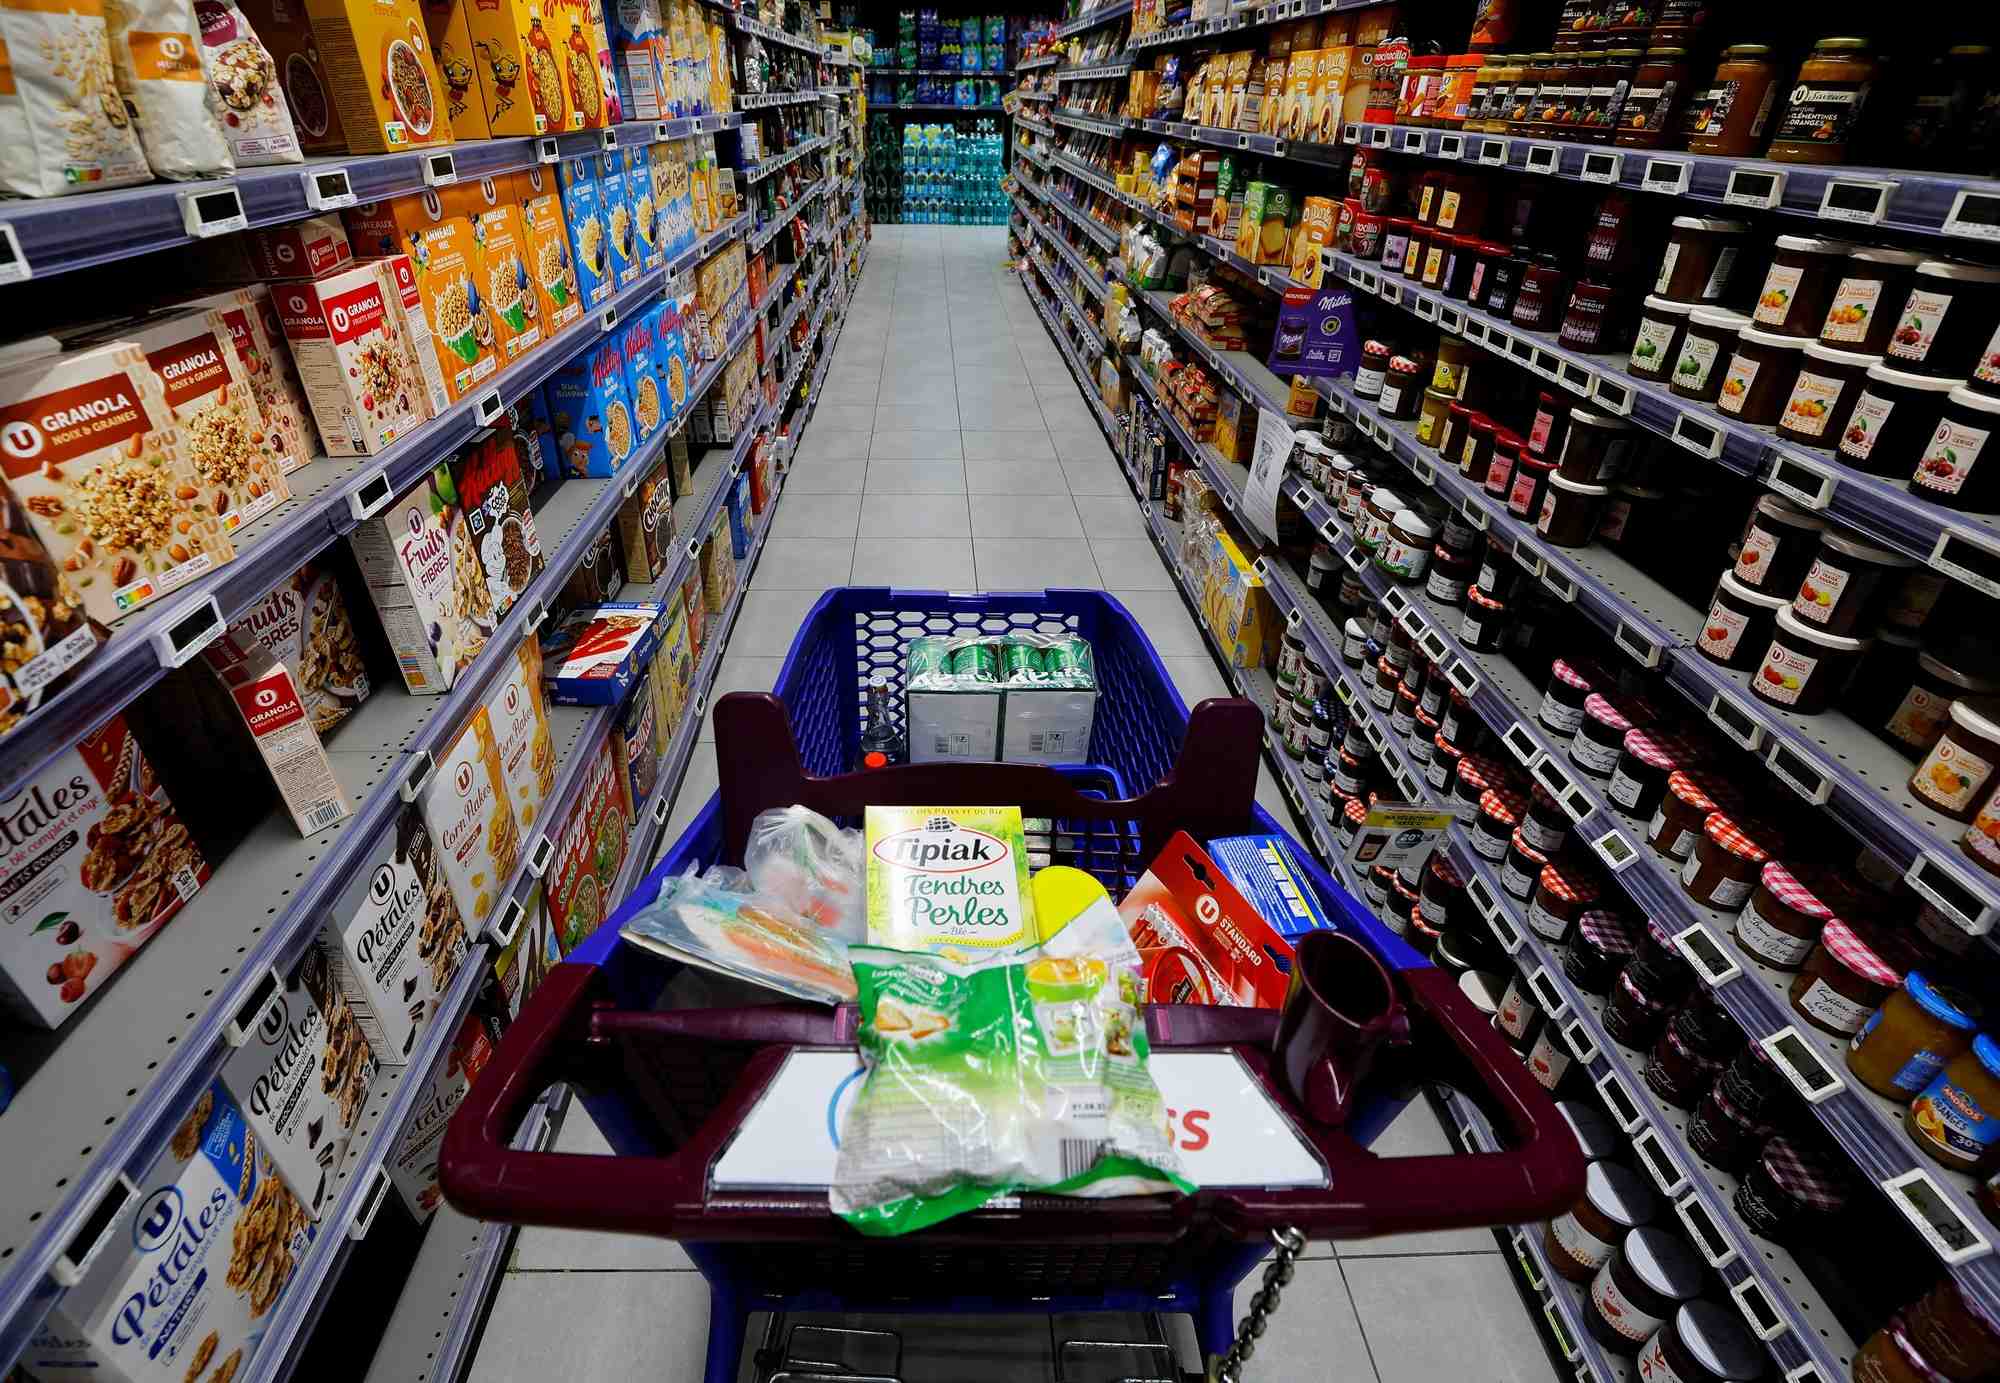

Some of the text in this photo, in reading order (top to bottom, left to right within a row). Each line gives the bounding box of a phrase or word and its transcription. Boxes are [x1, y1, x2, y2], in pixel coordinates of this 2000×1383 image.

[425, 223, 456, 243] ANNEAUX
[347, 295, 381, 317] GRANOLA
[1317, 294, 1353, 312] Milka
[162, 350, 219, 380] GRANOLA
[169, 378, 188, 393] NOIX
[194, 364, 224, 382] GRAINES
[40, 391, 131, 433] GRANOLA
[51, 429, 81, 447] NOIX
[92, 409, 139, 433] GRAINES
[400, 528, 446, 578] Fruits
[420, 552, 449, 590] FIBRES
[228, 592, 296, 635] ruits
[260, 616, 299, 650] BRES
[250, 700, 297, 726] GRANOLA
[895, 837, 992, 867] Tipiak
[904, 874, 1005, 897] Tendres
[357, 878, 420, 964] Pétales
[904, 896, 1009, 927] Perles
[1219, 917, 1264, 967] STANDARD
[250, 1004, 318, 1116] Pétales
[112, 1186, 227, 1346] Pétales
